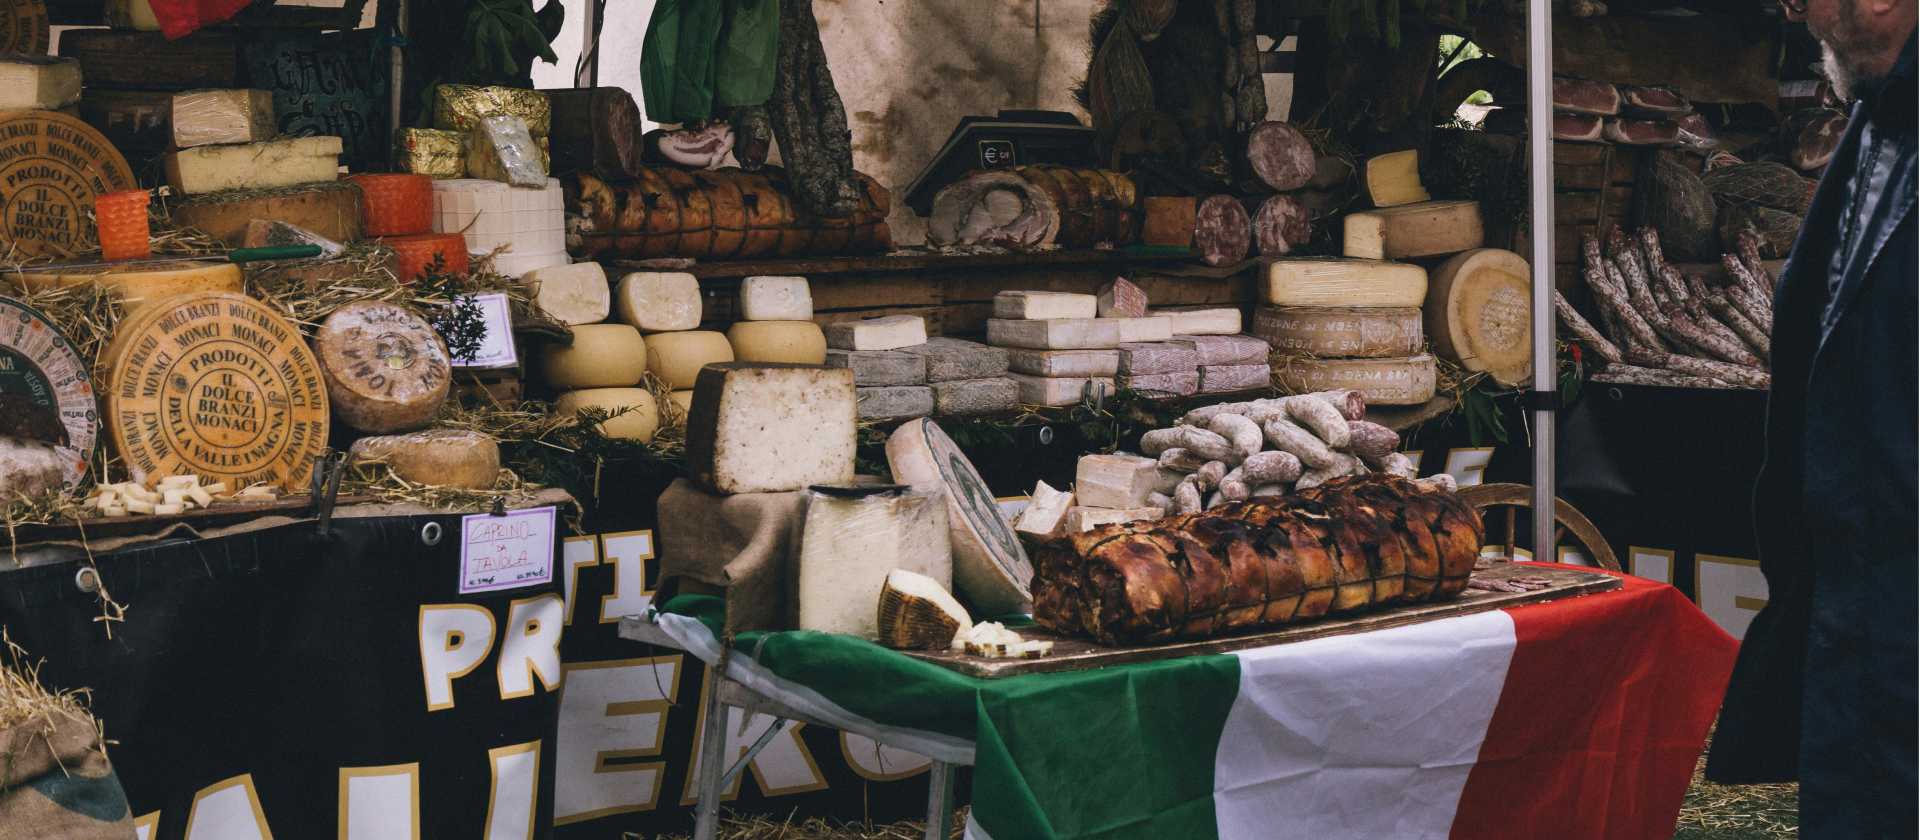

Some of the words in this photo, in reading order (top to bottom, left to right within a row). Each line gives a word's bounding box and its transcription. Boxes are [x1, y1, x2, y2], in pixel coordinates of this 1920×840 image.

[48, 143, 88, 171] MONACI
[7, 166, 87, 200] PRODOTTI
[36, 189, 48, 201] IL
[16, 213, 70, 231] BRANZI
[18, 201, 67, 217] DOLCE
[14, 226, 71, 244] MONACI
[158, 310, 188, 335] DOLCE
[186, 303, 220, 321] BRANZI
[229, 303, 257, 323] DOLCE
[258, 314, 289, 343] BRANZI
[130, 334, 159, 369] BRANZI
[173, 322, 220, 350] MONACI
[232, 323, 277, 355] MONACI
[121, 367, 141, 399] DOLCE
[142, 350, 173, 398] MONACI
[189, 349, 274, 386] PRODOTTI
[222, 374, 237, 388] IL
[279, 359, 306, 407] MONACI
[289, 345, 312, 376] DOLCE
[304, 375, 322, 410] BRANZI
[199, 400, 256, 419] BRANZI
[202, 385, 254, 404] DOLCE
[122, 410, 142, 447] BRANZI
[142, 411, 170, 460] MONACI
[169, 397, 192, 451] DELLA
[194, 445, 242, 468] VALLE
[244, 410, 284, 464] IMAGNA
[195, 414, 257, 433] MONACI
[281, 421, 307, 466] MONACI
[470, 521, 530, 546] CAPRINO
